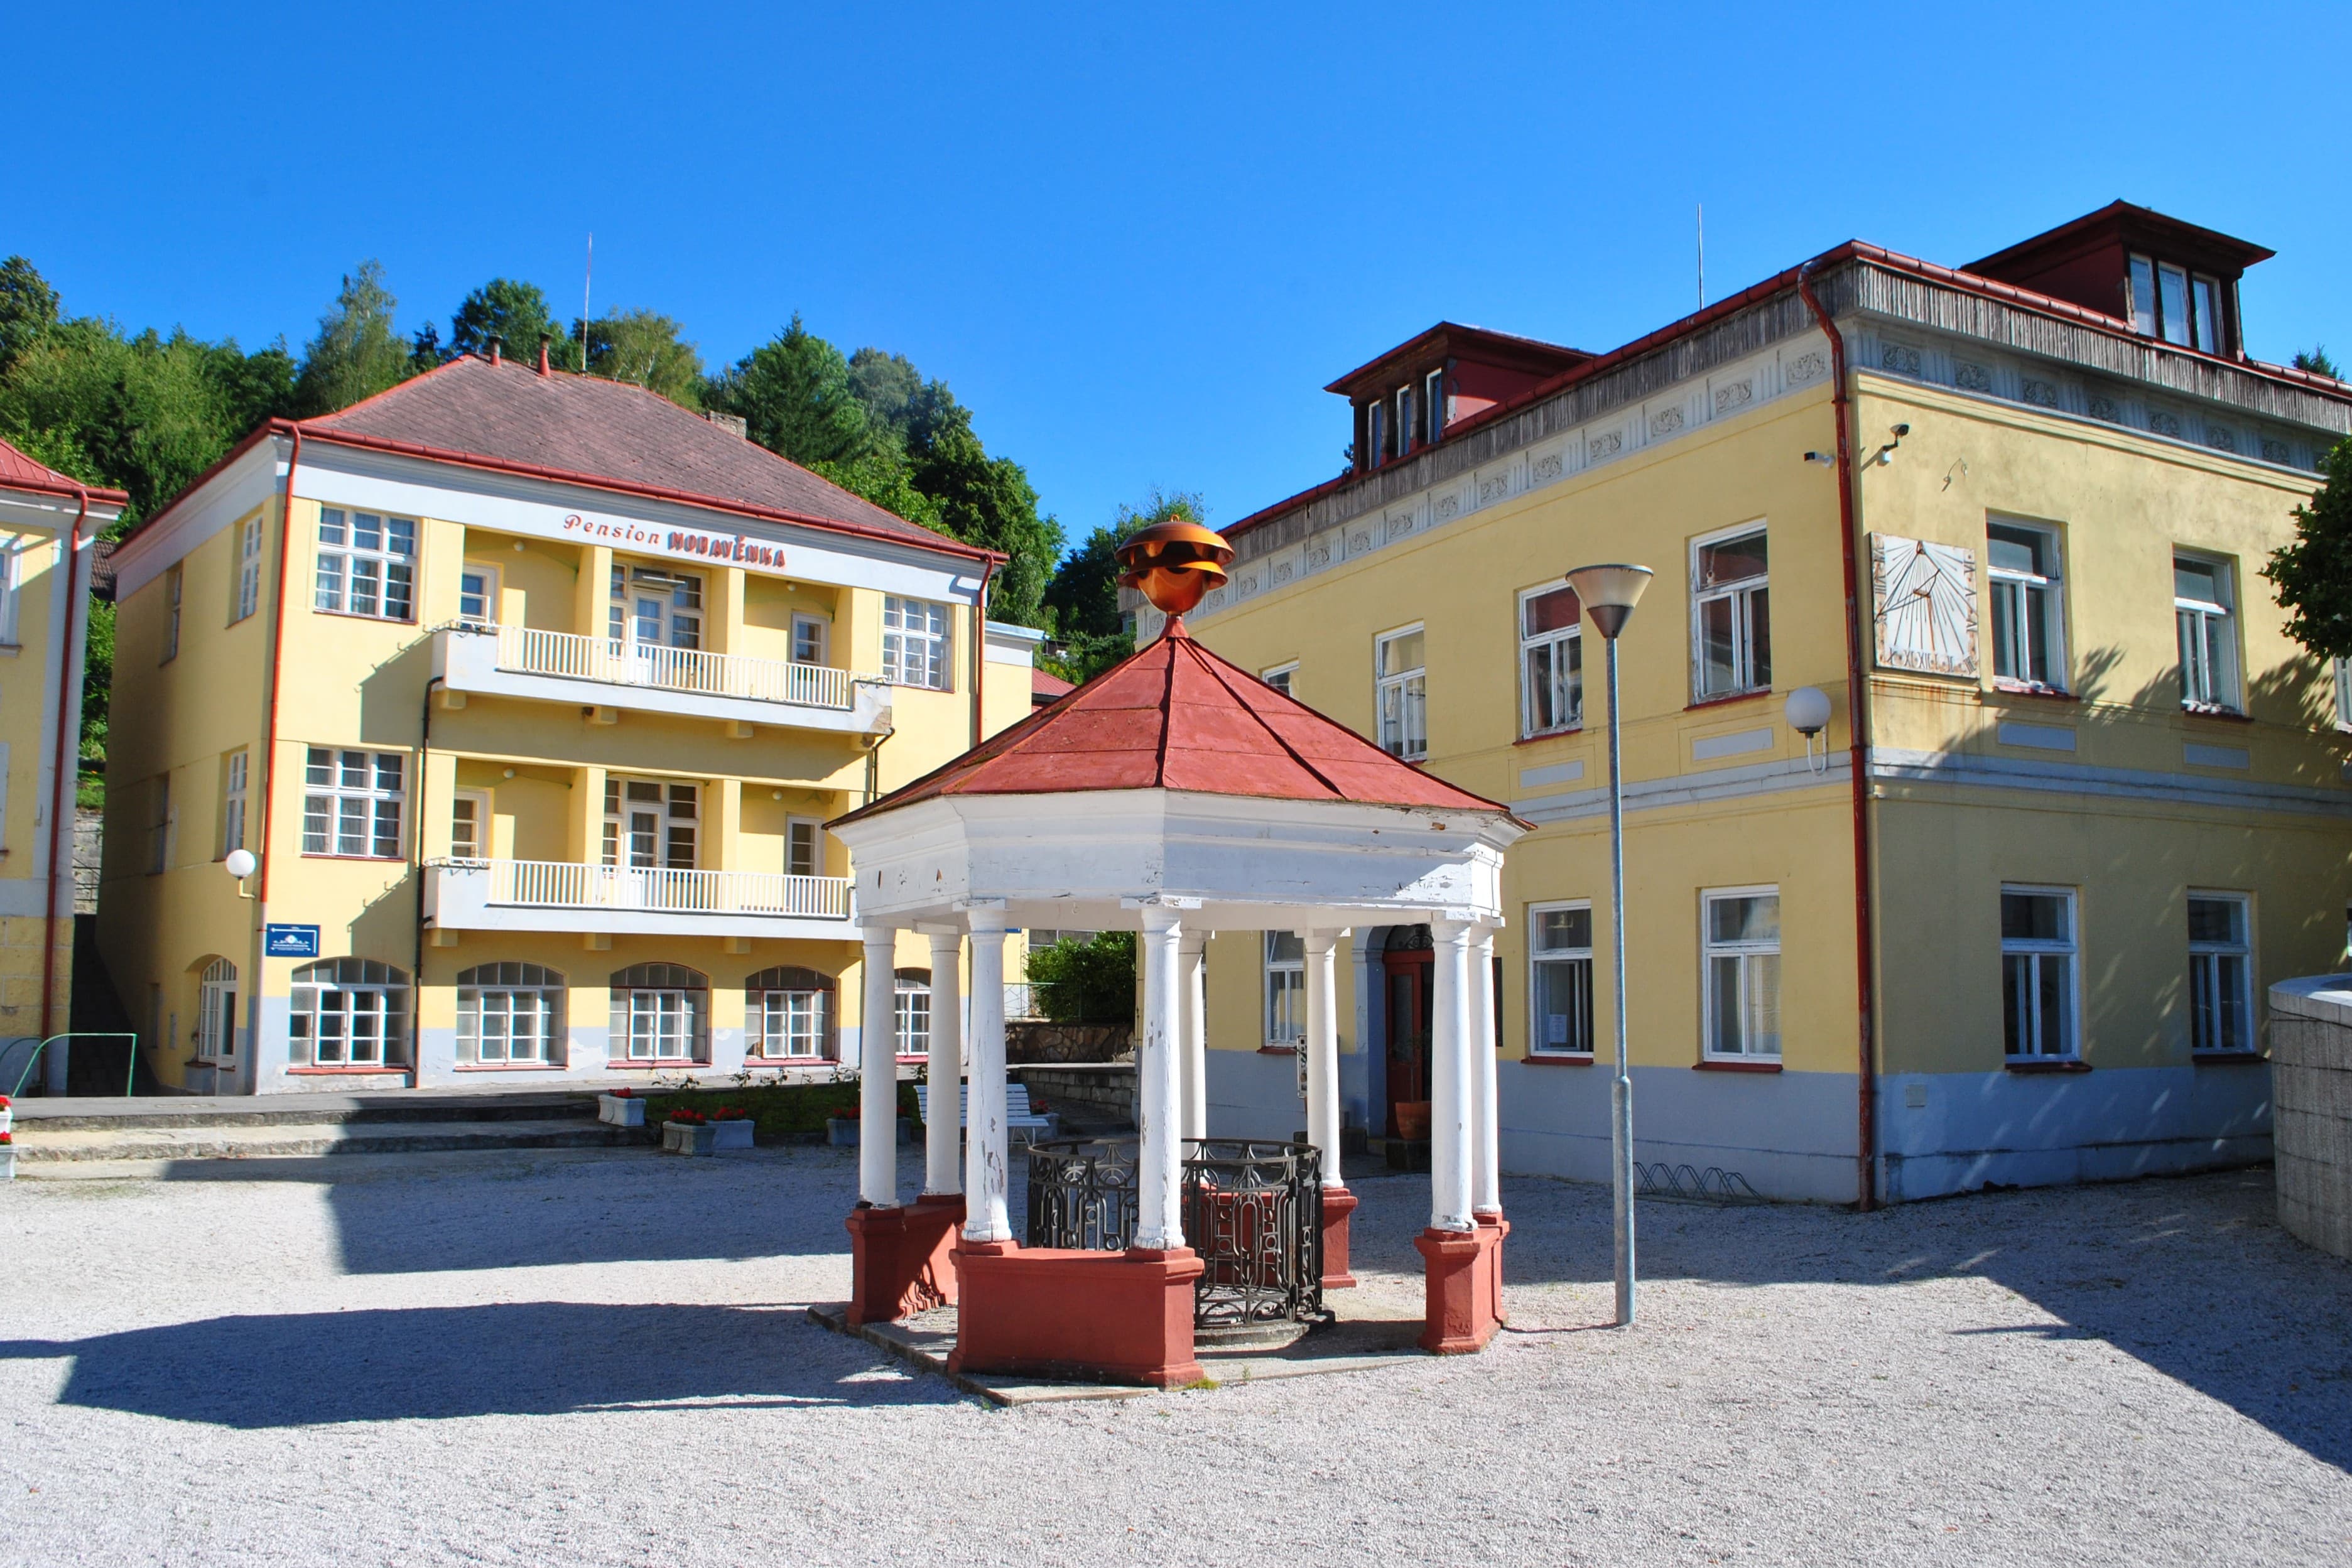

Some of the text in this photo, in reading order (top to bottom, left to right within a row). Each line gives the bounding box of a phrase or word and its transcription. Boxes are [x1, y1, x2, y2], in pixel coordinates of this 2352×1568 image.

[563, 514, 786, 568] Pension MORAVĚNKA
[1904, 649, 1914, 667] XI
[1917, 651, 1931, 669] XII
